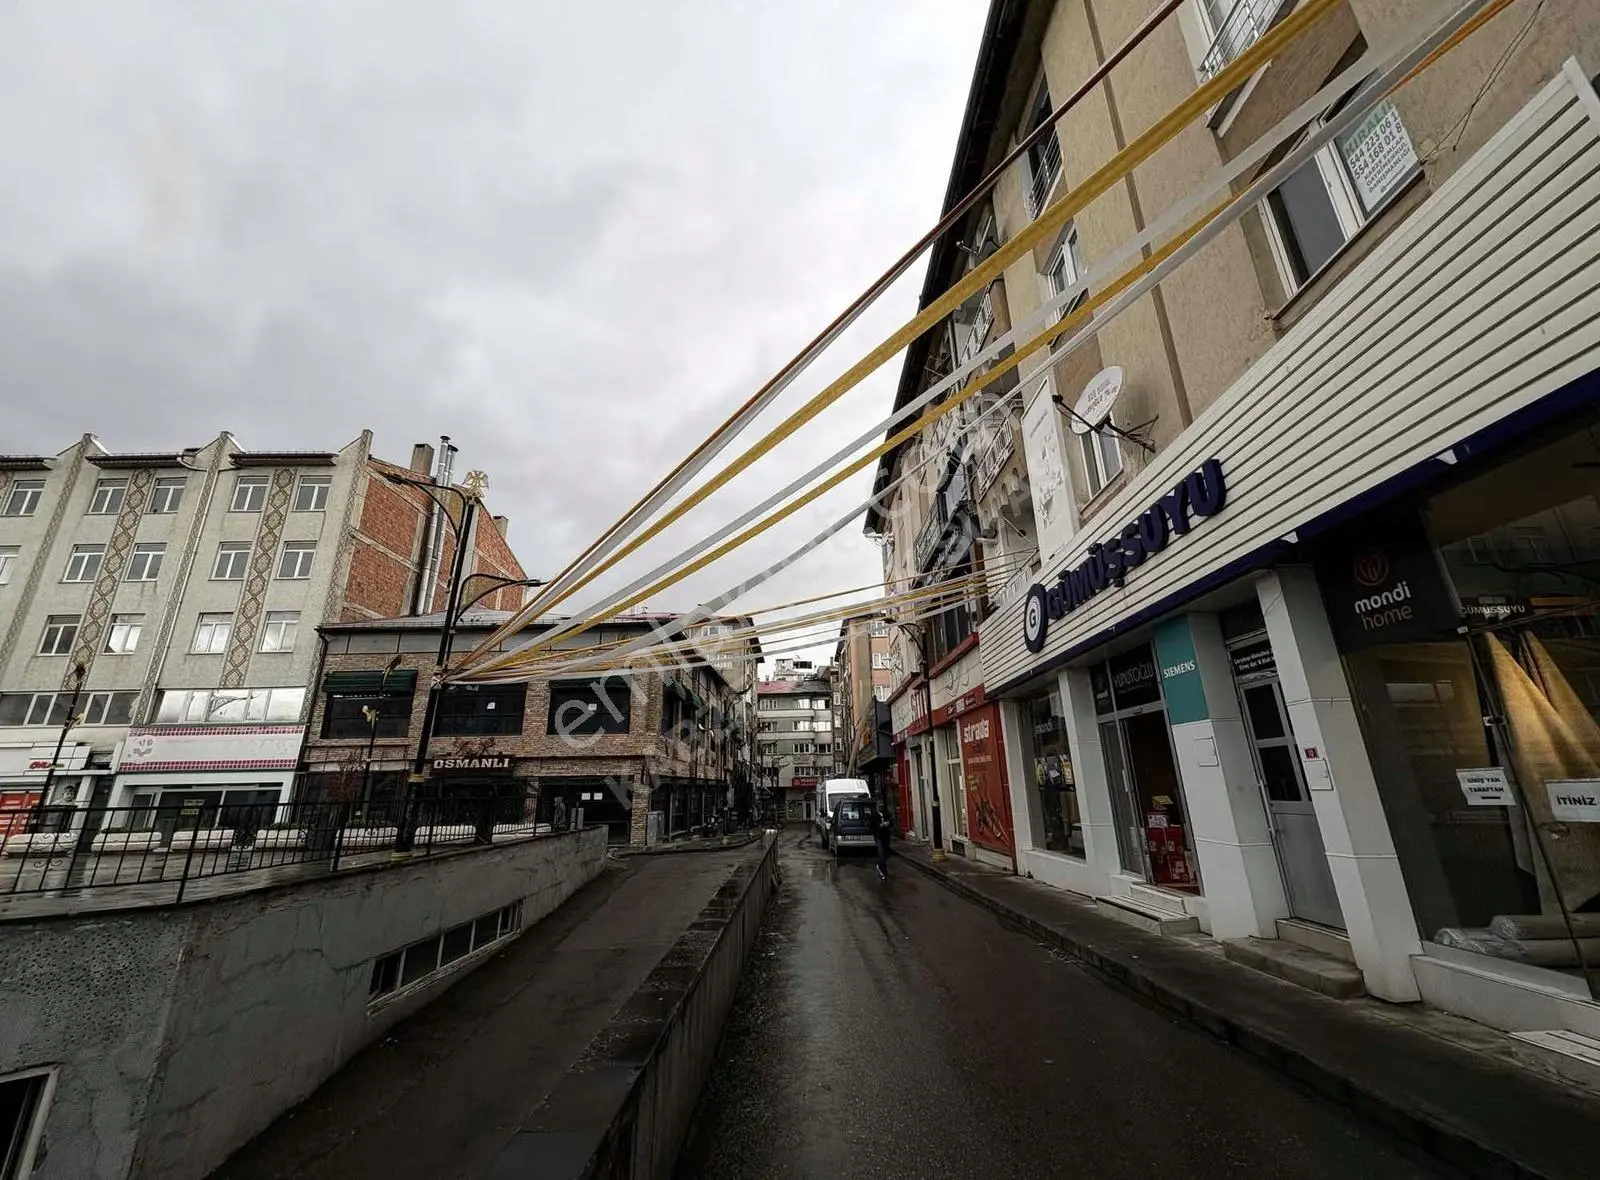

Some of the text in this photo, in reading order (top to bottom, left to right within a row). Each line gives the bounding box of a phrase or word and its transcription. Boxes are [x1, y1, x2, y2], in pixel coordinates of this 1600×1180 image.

[1365, 131, 1380, 151] 223
[1380, 117, 1391, 134] 06
[1354, 160, 1369, 180] 554
[1369, 143, 1384, 163] 168
[1384, 131, 1397, 146] 01
[1046, 458, 1227, 620] GÜMÜŞSUYU
[1353, 577, 1412, 614] mondi
[1360, 603, 1413, 632] home
[1163, 660, 1196, 679] SIEMENS
[433, 756, 510, 770] OSMANLI
